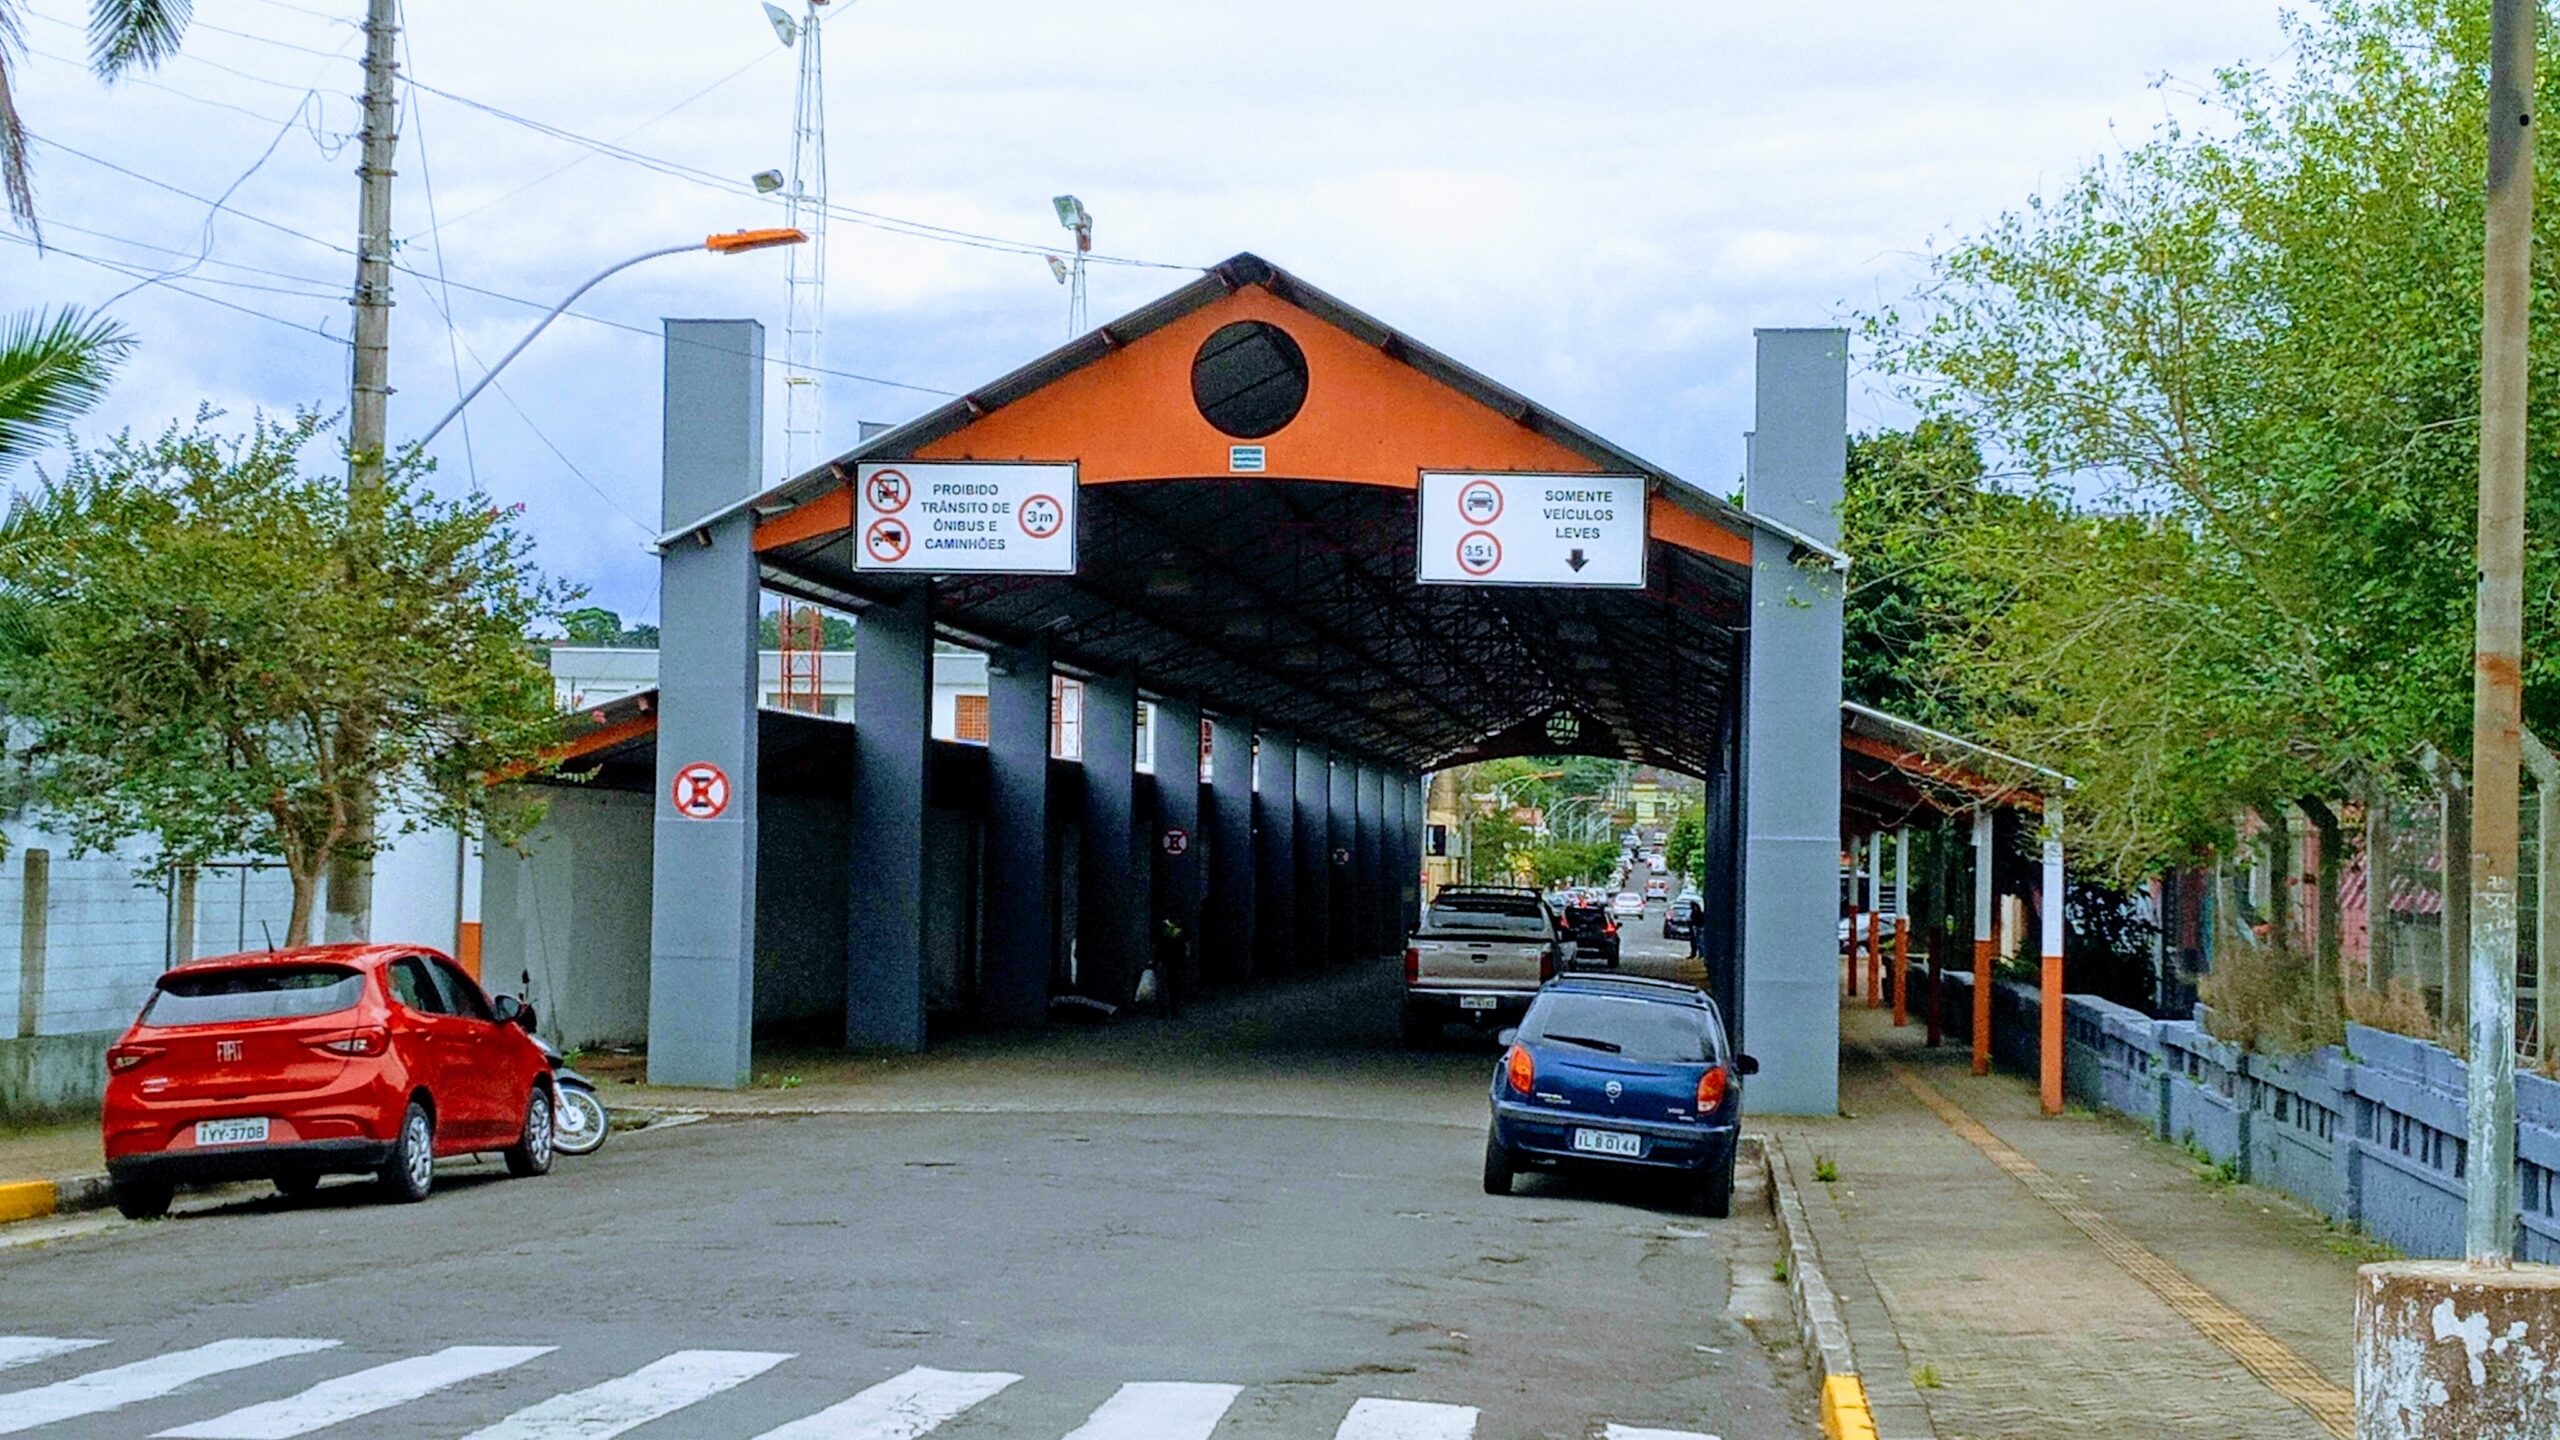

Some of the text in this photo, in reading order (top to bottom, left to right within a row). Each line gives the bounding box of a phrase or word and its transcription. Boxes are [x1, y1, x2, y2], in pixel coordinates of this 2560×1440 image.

[932, 484, 999, 496] PROIBIDO
[1545, 490, 1613, 502] SOMENTE
[921, 500, 1010, 514] TRÂNSITO DE
[1543, 507, 1614, 521] VEÍCULOS
[933, 518, 998, 532] ÔNIBUS E
[1555, 527, 1600, 539] LEVES
[924, 537, 1006, 550] CAMINHÕES
[216, 1040, 244, 1062] FIAT
